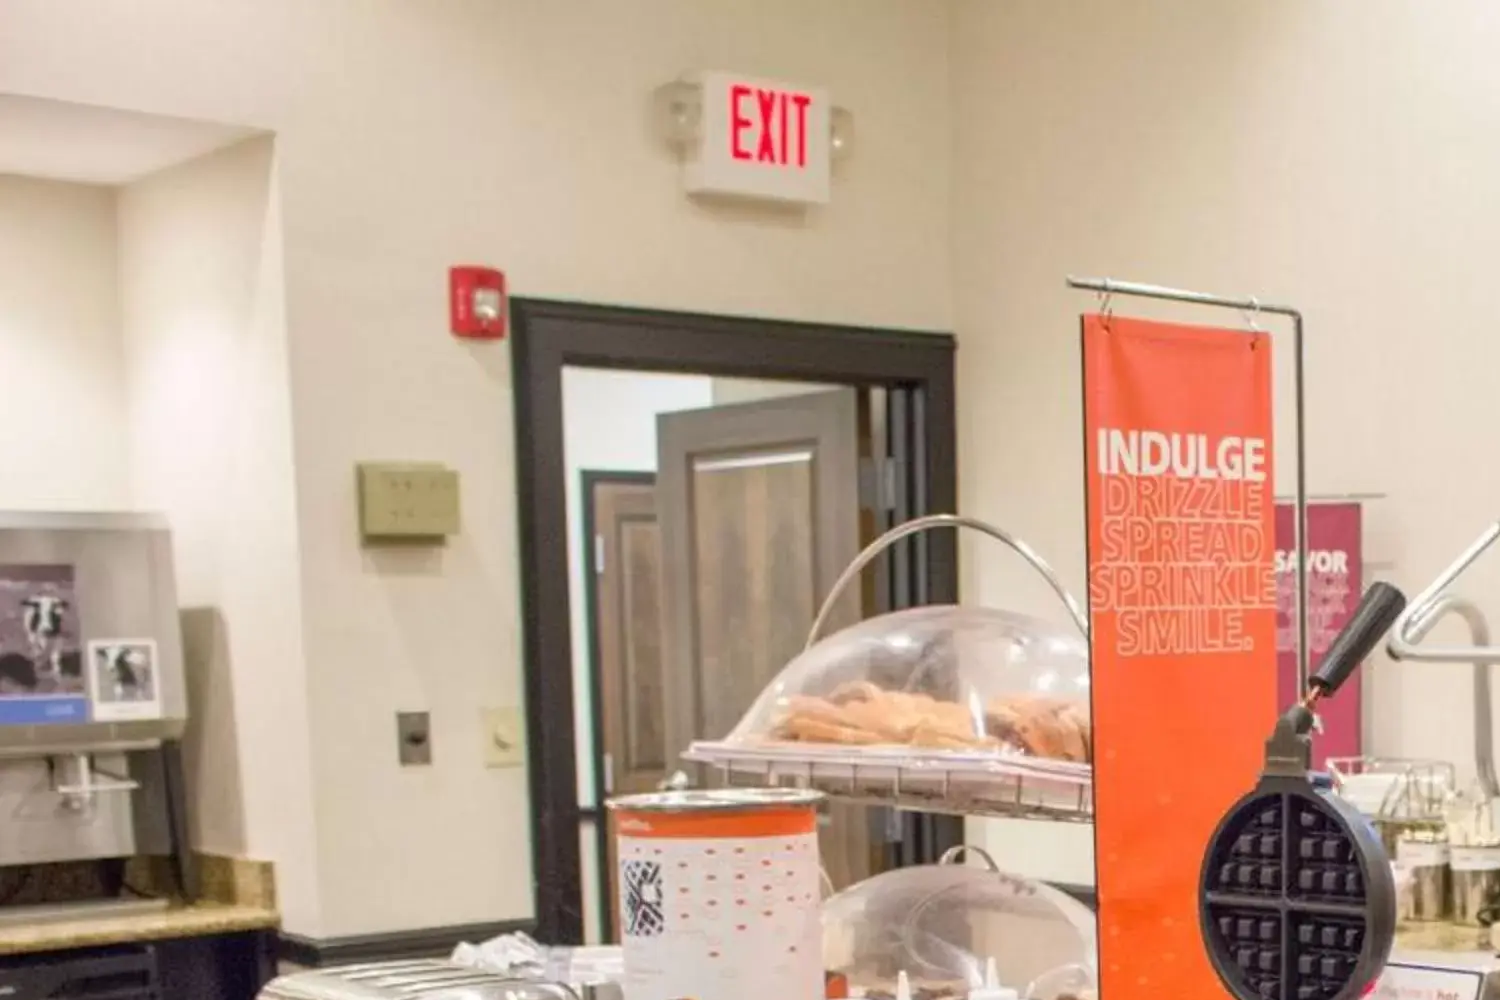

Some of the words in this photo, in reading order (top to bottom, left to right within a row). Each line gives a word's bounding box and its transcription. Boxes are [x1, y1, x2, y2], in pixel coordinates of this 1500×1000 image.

[730, 84, 811, 168] EXIT
[1097, 428, 1267, 481] INDULGE
[1102, 474, 1264, 522] DRIZZLE
[1101, 518, 1265, 566] SPREAD
[1088, 560, 1277, 613] SPRINKLE
[1117, 606, 1254, 657] SMILE.
